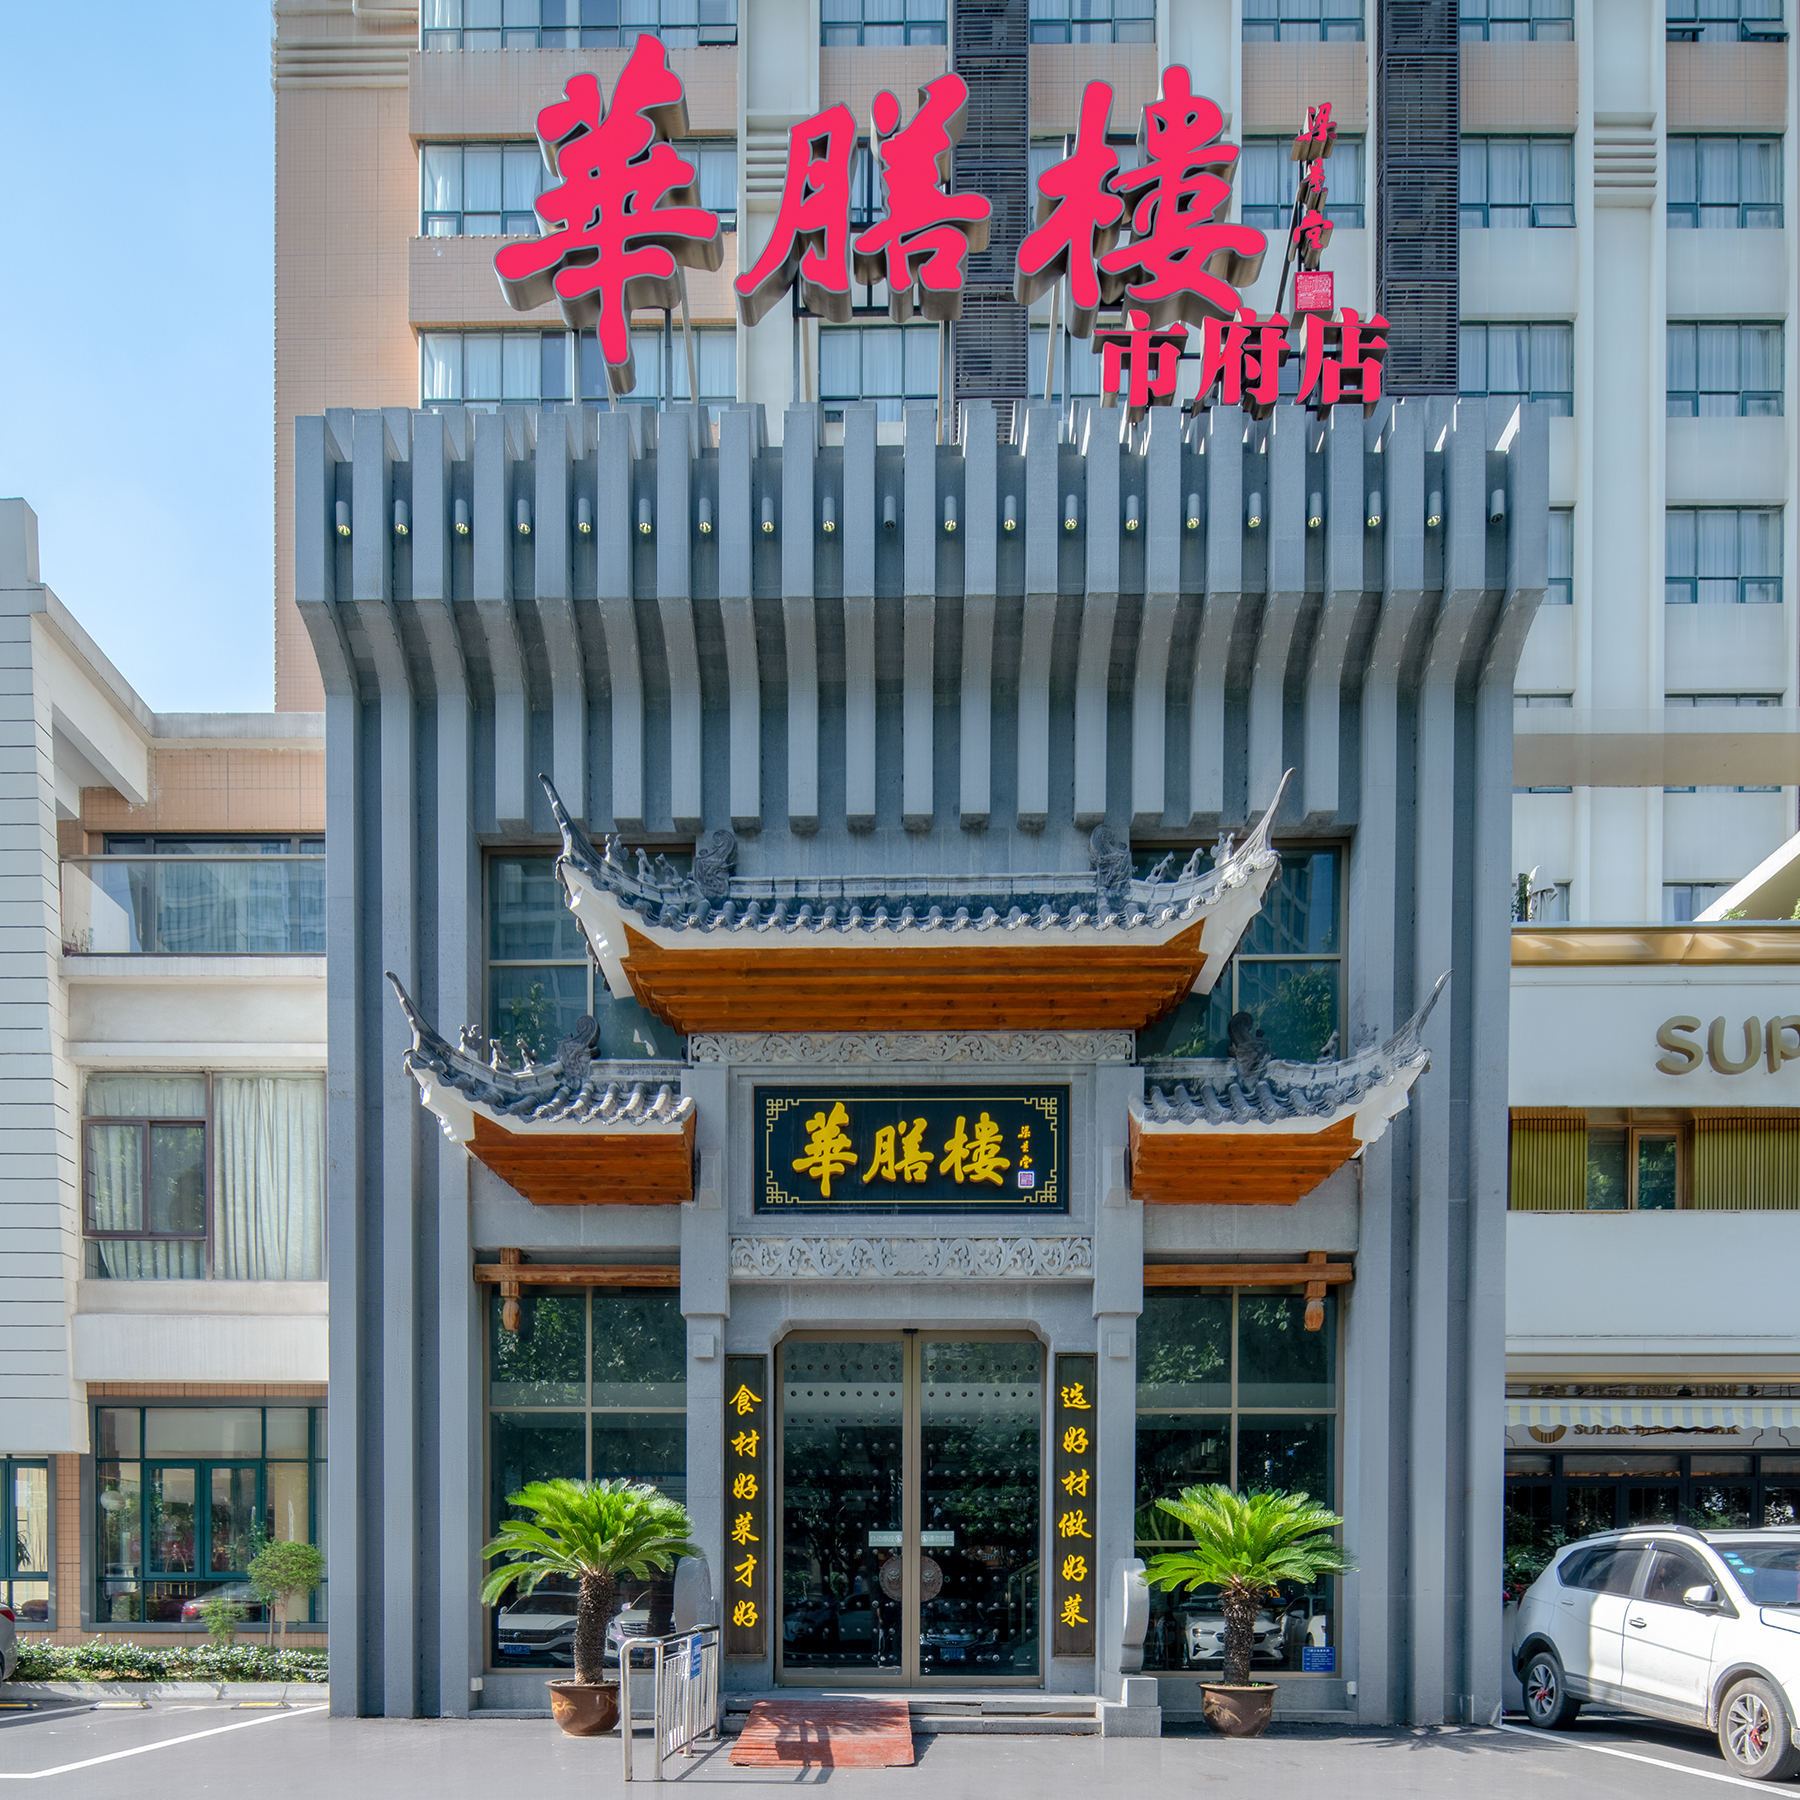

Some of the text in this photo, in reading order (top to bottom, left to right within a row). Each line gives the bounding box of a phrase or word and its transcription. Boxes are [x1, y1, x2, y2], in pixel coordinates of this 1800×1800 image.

[1092, 305, 1391, 407] 市府店
[728, 1383, 763, 1628] 食材好菜才好
[1057, 1382, 1093, 1628] 选好材做好菜
